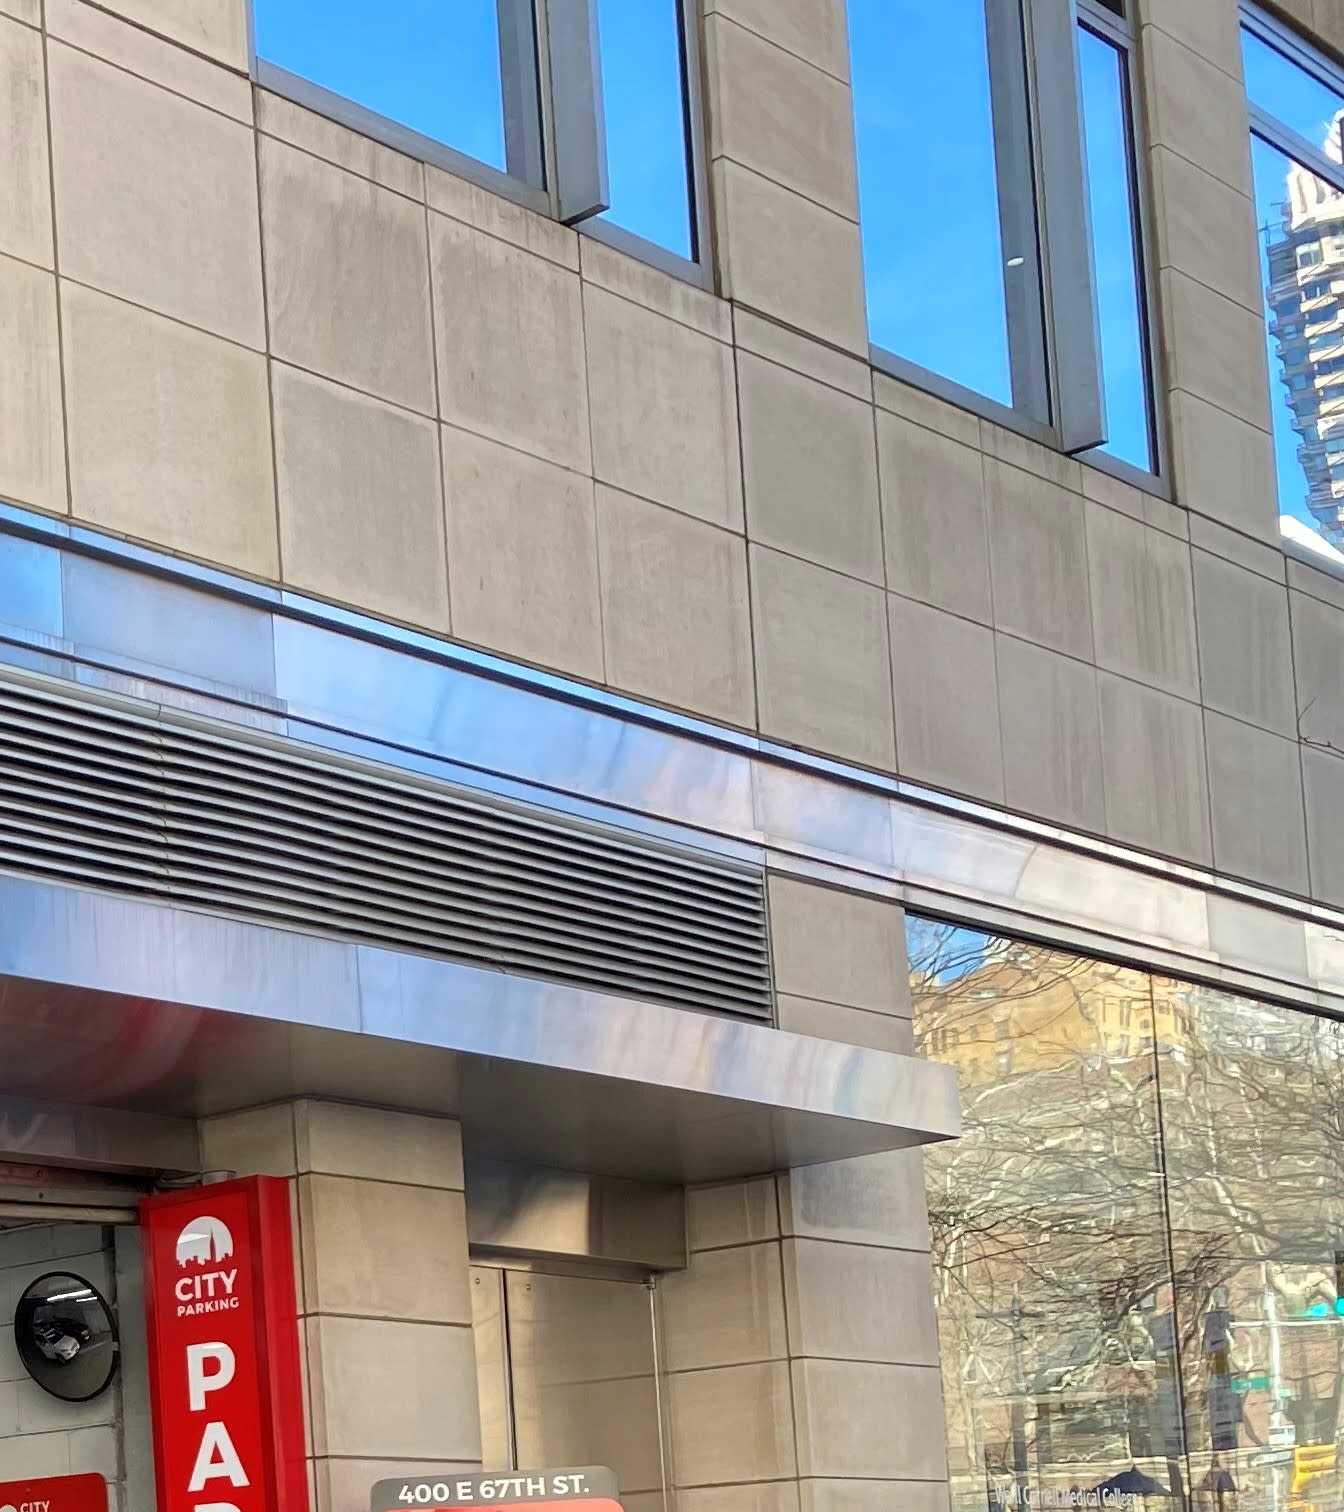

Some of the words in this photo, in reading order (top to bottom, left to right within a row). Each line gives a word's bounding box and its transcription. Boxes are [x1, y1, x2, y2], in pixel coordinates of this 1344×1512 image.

[175, 1269, 237, 1301] CITY
[177, 1297, 240, 1317] PARKING
[398, 1484, 450, 1504] 400
[456, 1481, 473, 1500] E
[479, 1477, 545, 1499] 67TH
[552, 1474, 590, 1495] ST.
